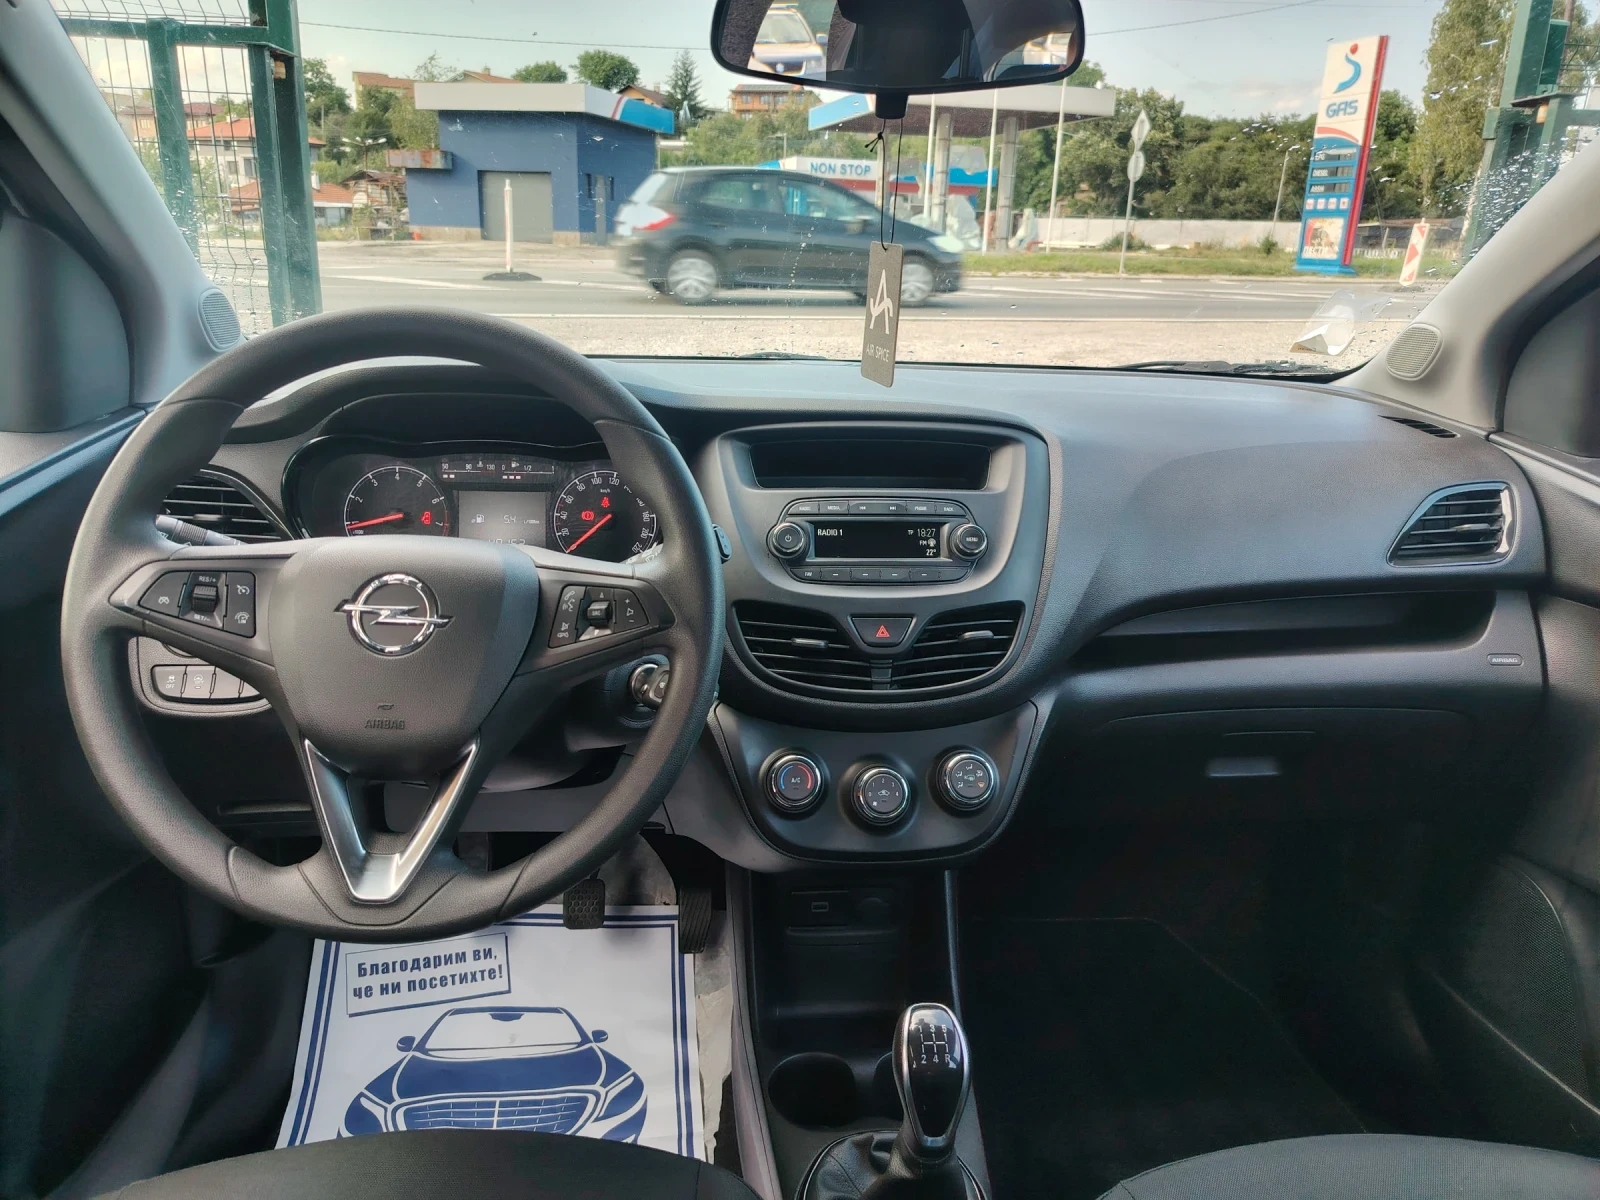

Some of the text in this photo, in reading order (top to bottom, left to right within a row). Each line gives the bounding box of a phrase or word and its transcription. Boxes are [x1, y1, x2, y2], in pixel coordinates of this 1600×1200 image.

[1325, 99, 1358, 118] GAS
[810, 162, 871, 176] NON STOP
[865, 343, 890, 363] AIR SPICE
[394, 472, 401, 481] 4
[590, 477, 603, 485] 100
[608, 477, 620, 486] 120
[371, 479, 379, 487] 3
[416, 479, 424, 487] 5
[576, 483, 586, 492] 80
[565, 494, 574, 504] 60
[560, 510, 568, 520] 40
[642, 511, 650, 522] 180
[561, 527, 570, 537] 20
[640, 527, 650, 539] 200
[817, 528, 843, 536] RADIO 1
[917, 528, 936, 538] 18:27
[631, 541, 643, 554] 220
[926, 548, 937, 556] 22°
[364, 719, 406, 730] AIRBAG
[357, 947, 498, 978] Благодарим ви,
[352, 964, 503, 999] че ни посетихте!
[921, 1054, 951, 1064] 2 4 R
